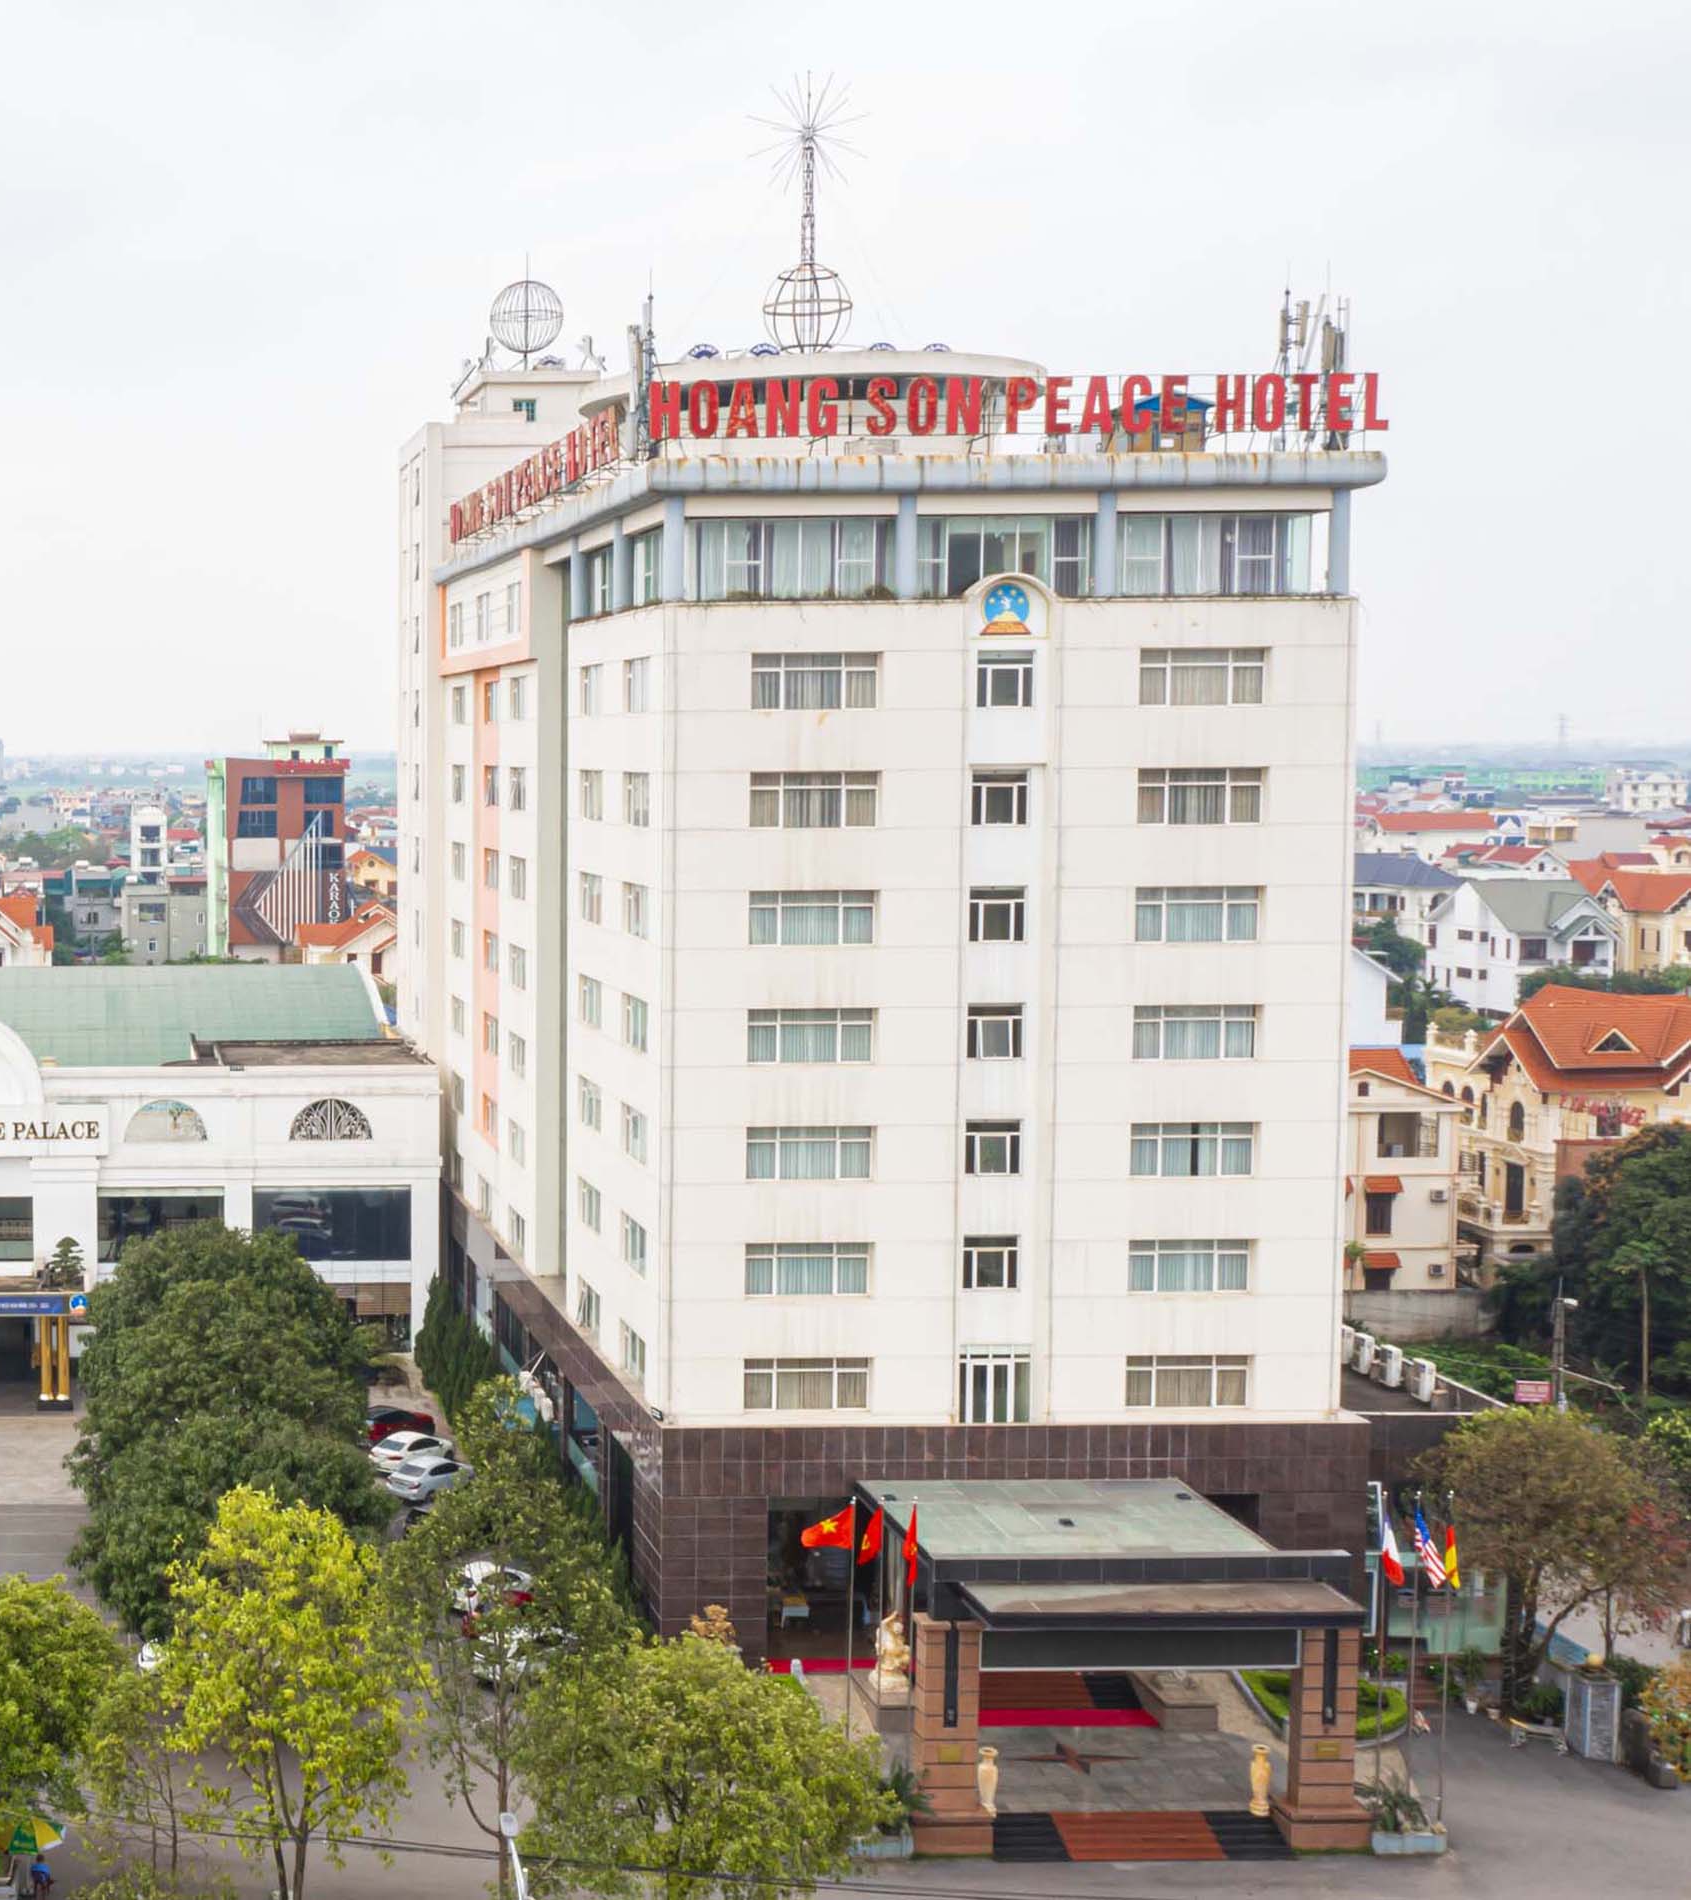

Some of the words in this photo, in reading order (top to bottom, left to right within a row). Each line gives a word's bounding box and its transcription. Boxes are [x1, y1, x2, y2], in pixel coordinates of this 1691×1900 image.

[649, 376, 839, 439] HOANG
[866, 376, 983, 436] SON
[1006, 374, 1189, 435] PEACE
[1215, 373, 1389, 432] HOTEL
[13, 1120, 100, 1141] PALACE
